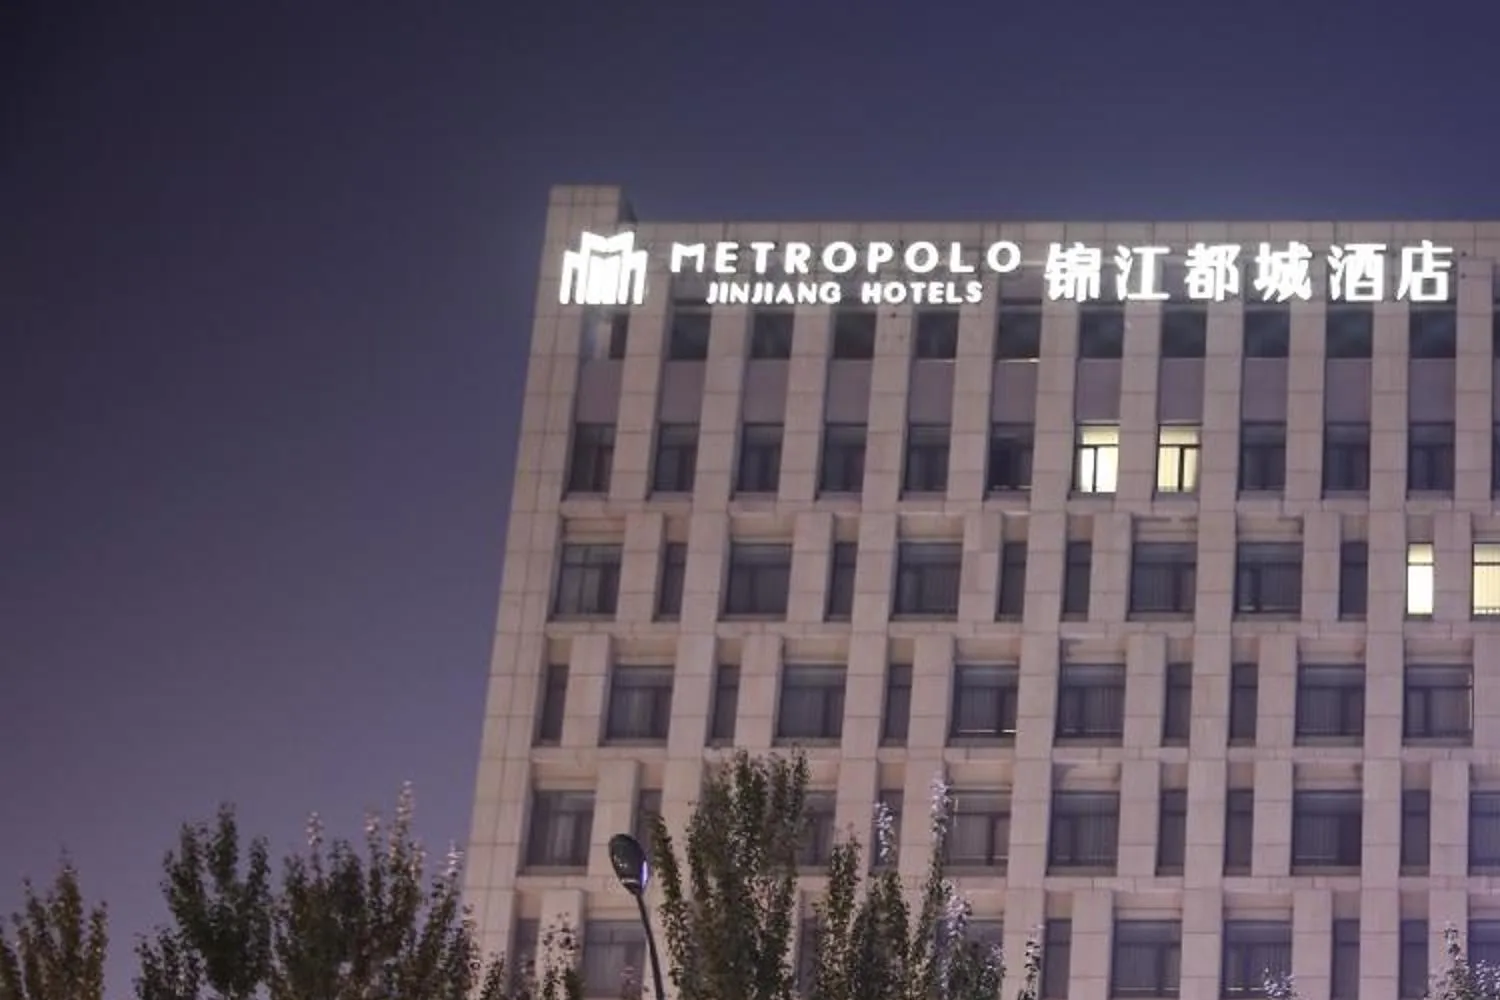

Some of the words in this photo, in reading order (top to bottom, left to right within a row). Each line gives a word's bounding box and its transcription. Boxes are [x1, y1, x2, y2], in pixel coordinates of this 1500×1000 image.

[670, 241, 1021, 274] METROPOLO
[1043, 240, 1453, 303] 锦江都城酒店
[706, 281, 841, 304] JINJIANG
[861, 281, 983, 304] HOTELS
